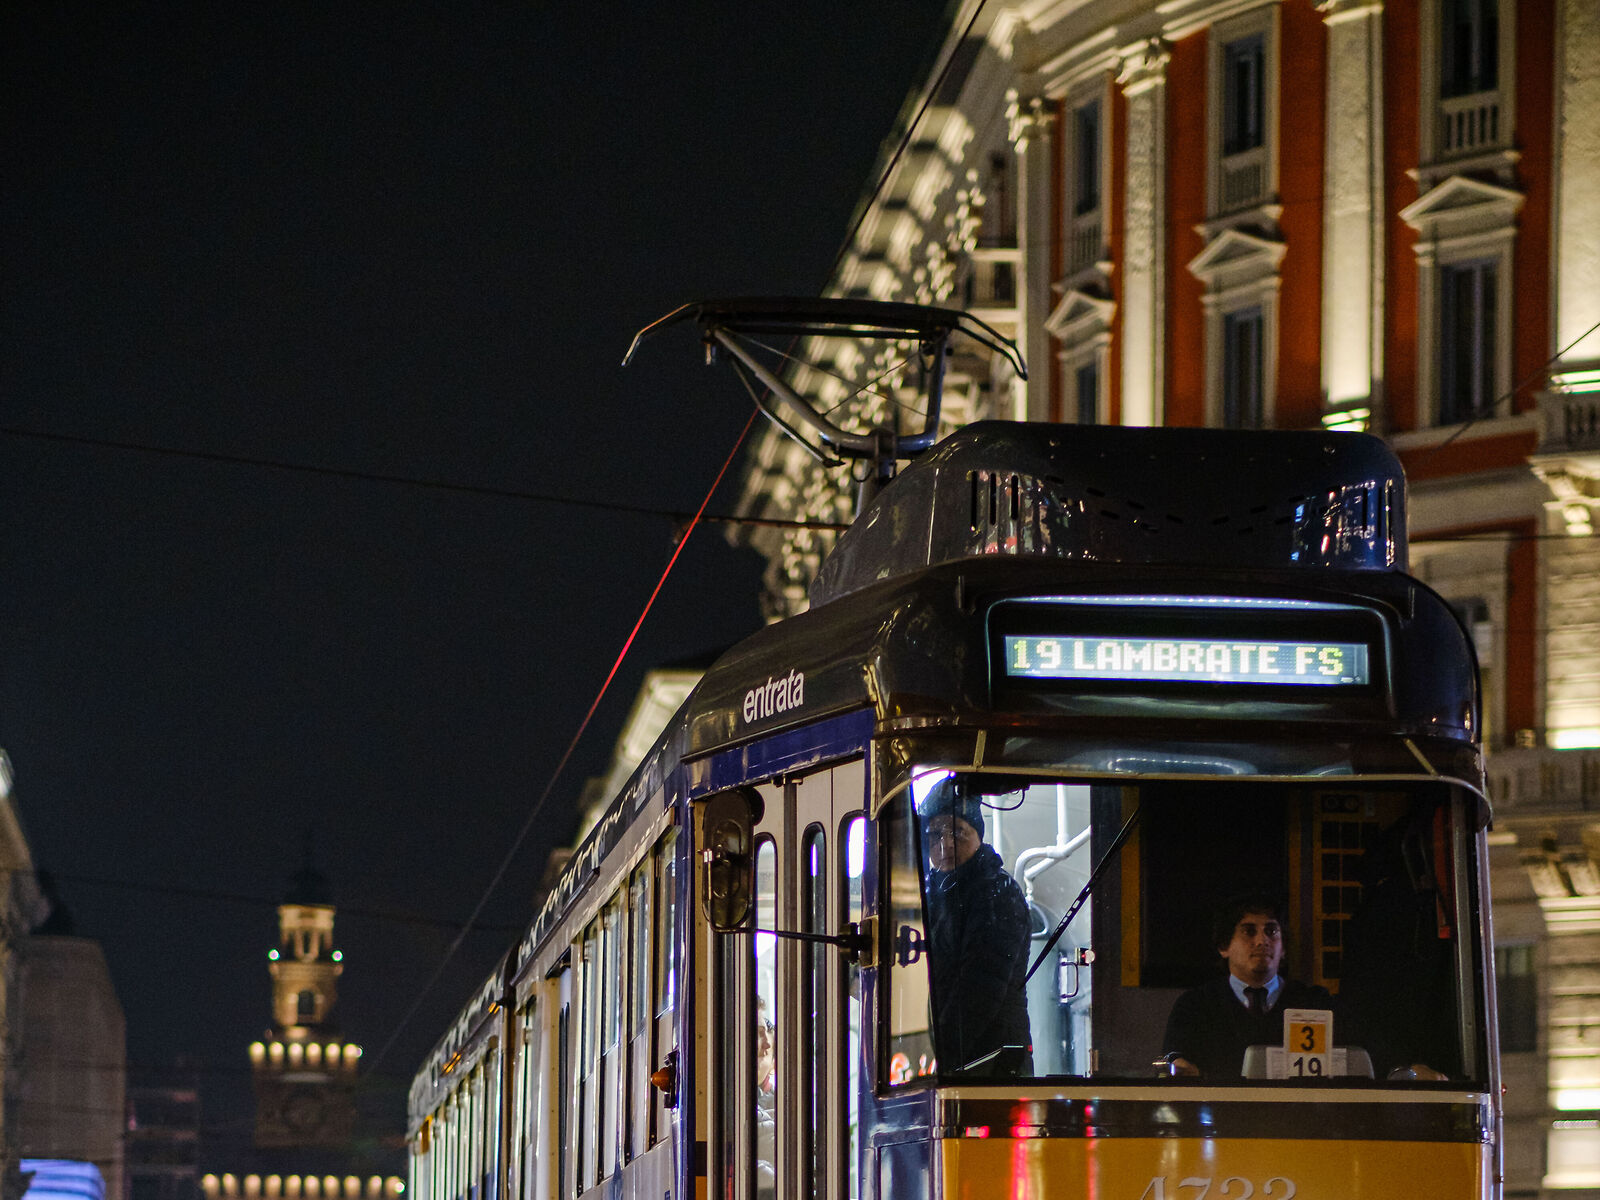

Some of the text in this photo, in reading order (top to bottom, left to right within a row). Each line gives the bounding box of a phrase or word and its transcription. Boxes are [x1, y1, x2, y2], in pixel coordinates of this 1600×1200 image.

[1013, 640, 1344, 676] 19 LAMBRATE FS
[743, 668, 804, 724] entrata
[1301, 1025, 1315, 1051] 3
[1293, 1057, 1322, 1077] 19
